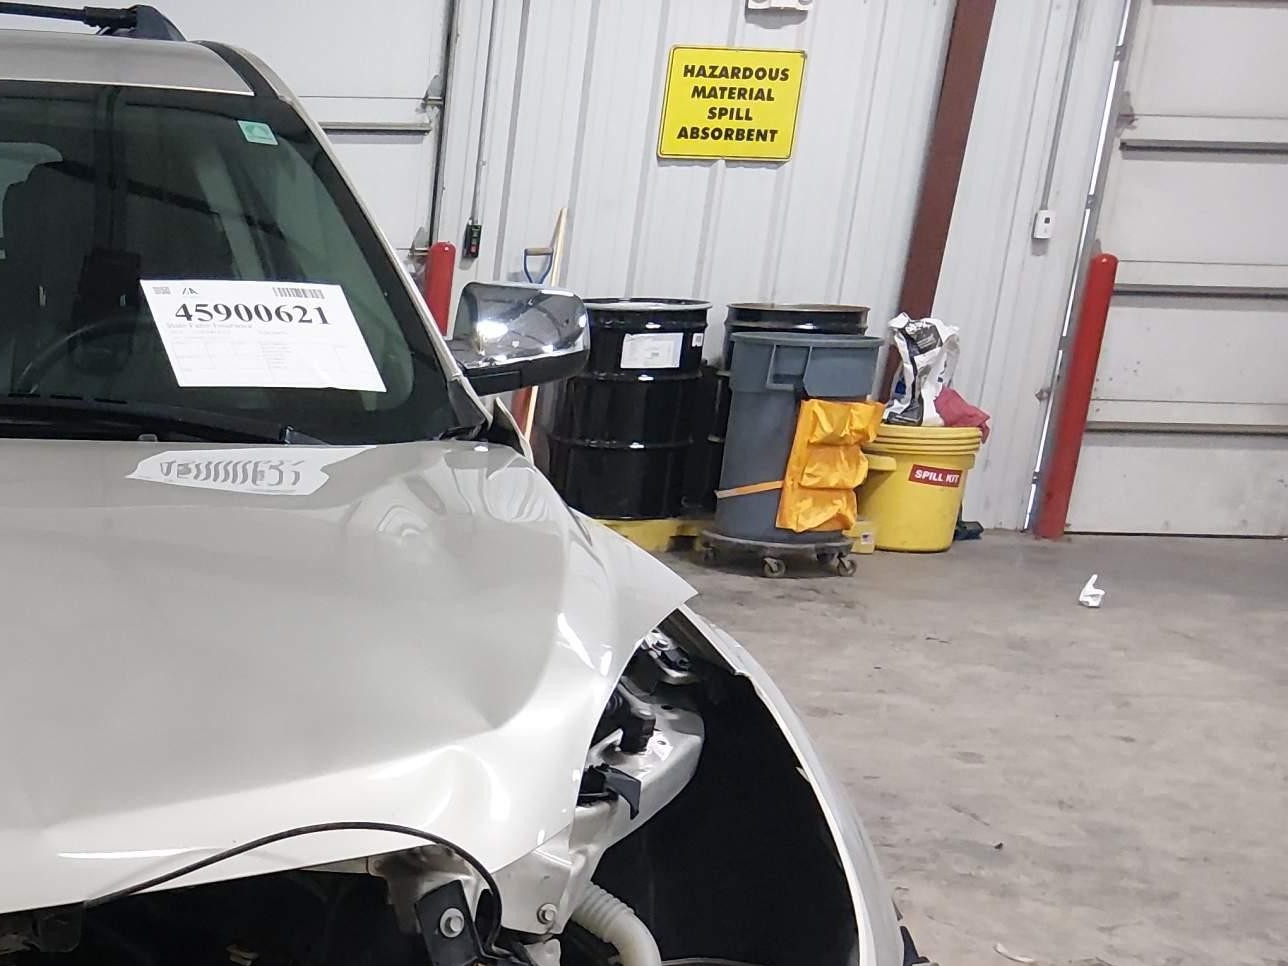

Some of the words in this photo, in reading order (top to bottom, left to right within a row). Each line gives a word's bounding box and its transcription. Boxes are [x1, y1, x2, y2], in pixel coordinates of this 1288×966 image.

[683, 65, 790, 81] HAZARDOUS
[691, 86, 775, 101] MATERIAL
[707, 107, 753, 121] SPILL
[677, 126, 778, 142] ABSORBENT
[175, 303, 330, 325] 45900621
[914, 469, 943, 481] SPILL
[946, 474, 959, 483] KIT
